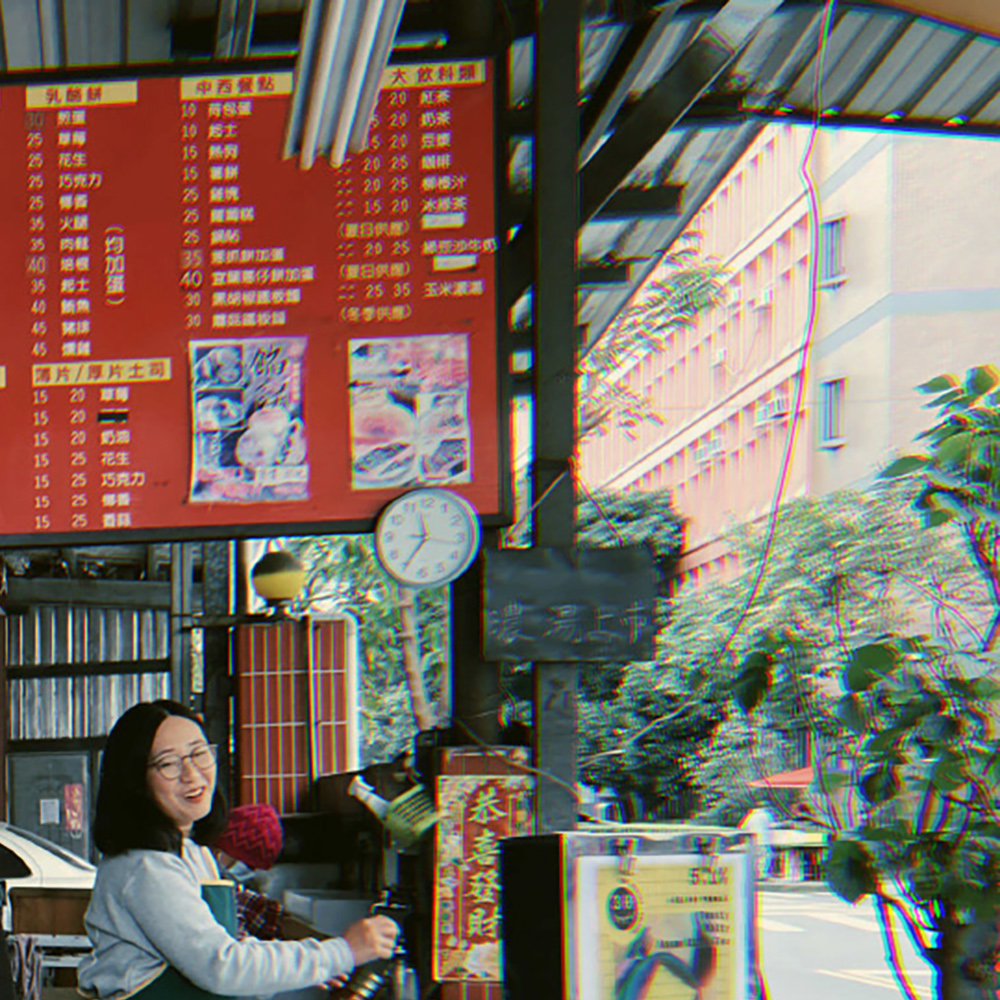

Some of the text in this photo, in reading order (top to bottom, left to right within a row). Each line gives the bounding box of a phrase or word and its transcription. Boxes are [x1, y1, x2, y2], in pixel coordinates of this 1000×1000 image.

[392, 64, 475, 84] 大 飲料類
[197, 76, 274, 95] 中西餐點
[46, 87, 101, 103] 乳酪餅
[390, 91, 406, 105] 20
[182, 103, 196, 116] 10
[390, 114, 407, 126] 20
[182, 125, 196, 137] 10
[28, 133, 42, 146] 25
[391, 135, 407, 149] 20
[183, 146, 197, 159] 15
[28, 153, 87, 167] 25 花生
[364, 158, 380, 171] 20
[392, 156, 408, 169] 25
[183, 167, 198, 180] 15
[29, 174, 102, 188] 25 巧克力
[365, 179, 381, 192] 20
[392, 177, 408, 191] 25
[183, 188, 198, 202] 25
[29, 197, 43, 209] 25
[365, 200, 381, 213] 15
[392, 199, 409, 212] 20
[184, 209, 199, 223] 25
[30, 217, 44, 230] 35
[185, 230, 200, 243] 25
[31, 238, 45, 251] 35
[365, 243, 382, 255] 20
[393, 242, 410, 254] 25
[31, 279, 45, 292] 35
[181, 271, 202, 286] 40
[366, 285, 383, 298] 25
[394, 283, 410, 296] 35
[31, 300, 45, 313] 40
[186, 293, 200, 306] 30
[32, 322, 46, 334] 45
[187, 315, 200, 327] 30
[32, 343, 47, 356] 45
[34, 388, 85, 403] 15 20
[34, 410, 85, 425] 15 20
[34, 433, 48, 446] 15
[71, 431, 85, 444] 20
[34, 452, 130, 467] 15 25 花生
[35, 473, 145, 488] 15 25 巧克力
[35, 495, 87, 508] 15 25
[422, 498, 435, 507] 12
[35, 514, 87, 529] 15 25
[392, 515, 403, 525] 10
[464, 786, 507, 938] 恭喜發財
